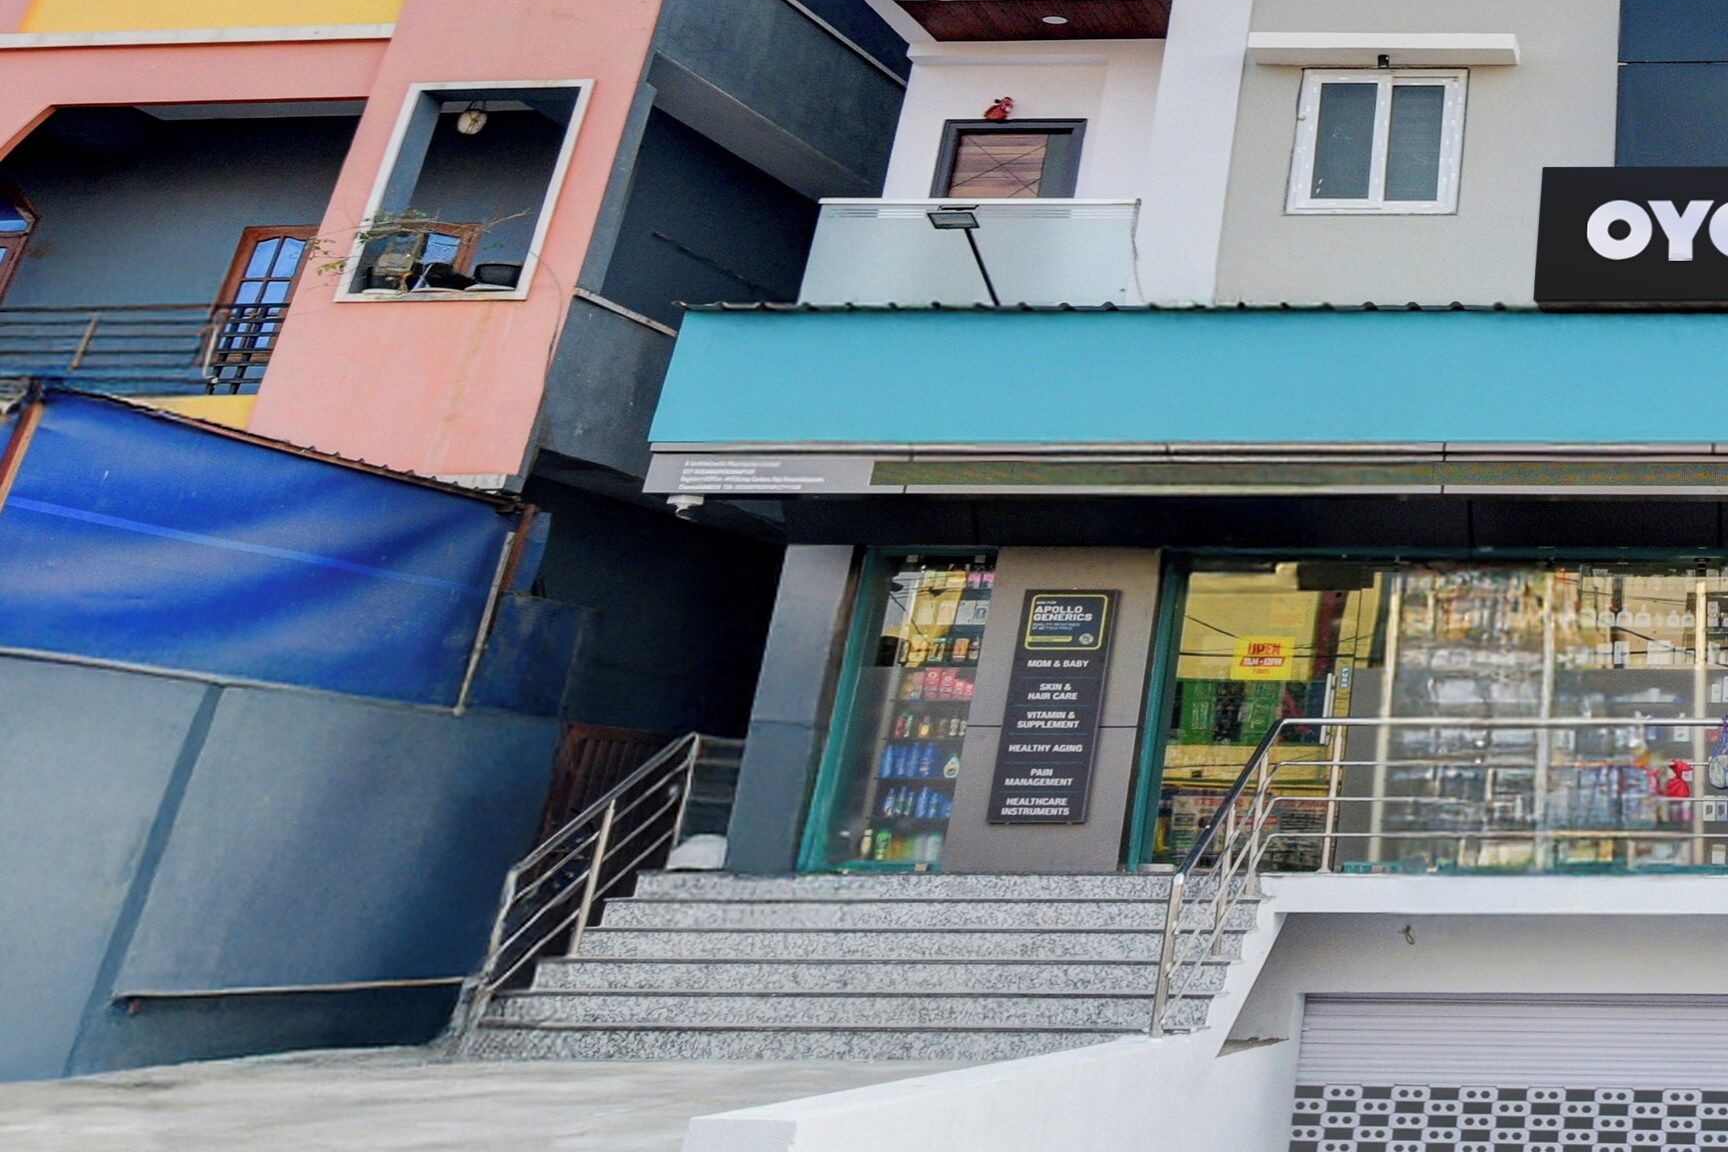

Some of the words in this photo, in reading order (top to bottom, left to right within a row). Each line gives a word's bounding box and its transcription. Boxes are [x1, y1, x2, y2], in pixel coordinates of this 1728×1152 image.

[1034, 605, 1083, 614] APOLLO
[1033, 613, 1093, 622] GENERICS
[1027, 659, 1051, 667] MOM
[1040, 683, 1062, 691] SKIN
[1063, 683, 1071, 691] &
[1027, 692, 1051, 700] HAIR
[1053, 692, 1078, 700] CARE
[1027, 711, 1066, 719] VITAMIN
[1067, 711, 1075, 719] &
[1016, 720, 1080, 729] SUPPLEMENT
[1008, 744, 1051, 752] HEALTHY
[1052, 744, 1083, 752] AGING
[1030, 768, 1053, 776] PAIN
[1004, 777, 1073, 786] MANAGEMENT
[1006, 797, 1068, 806] HEALTHCARE
[1001, 807, 1070, 816] INSTRUMENTS
